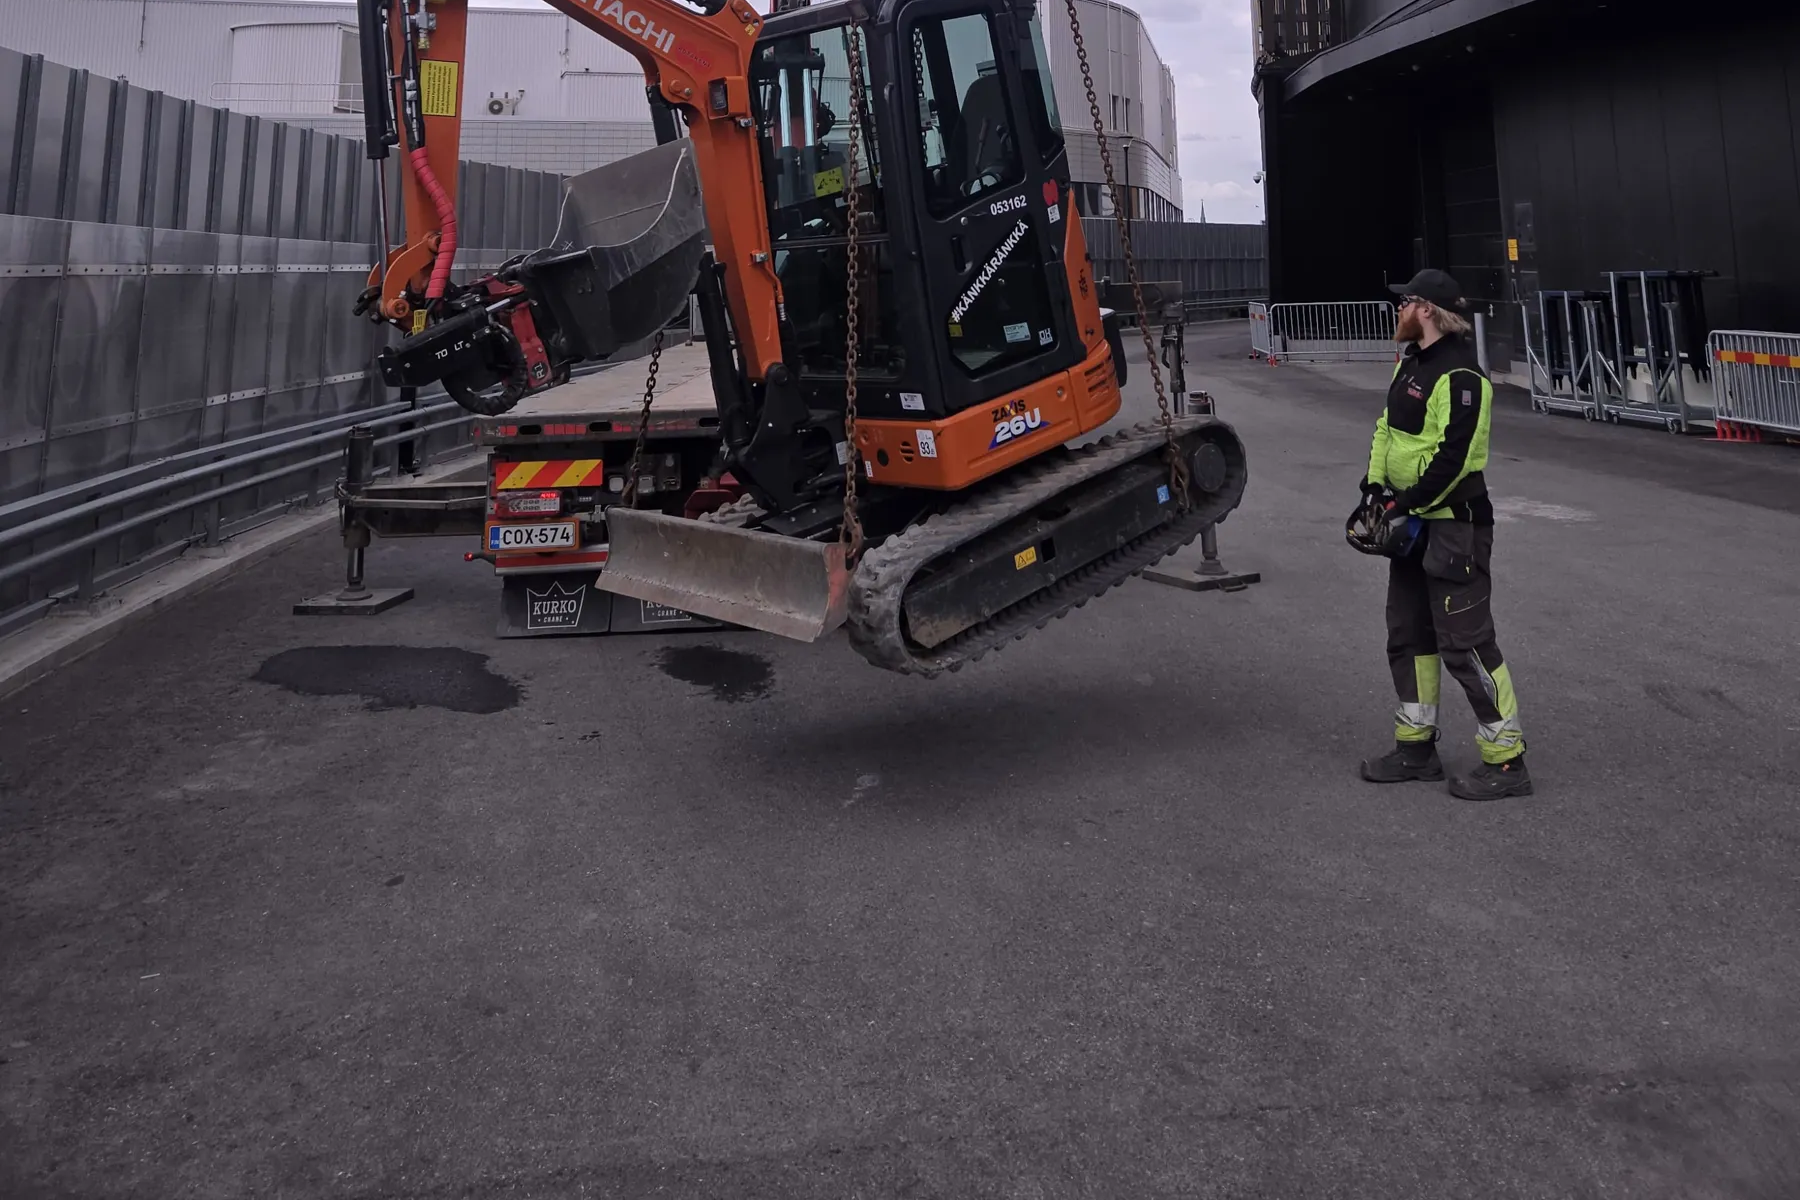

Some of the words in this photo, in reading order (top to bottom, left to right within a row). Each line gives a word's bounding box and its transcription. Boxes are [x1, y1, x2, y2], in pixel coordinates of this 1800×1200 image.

[990, 194, 1027, 215] 053162
[951, 219, 1029, 323] #KÄNKKÄRÄNKKÄ
[991, 399, 1026, 423] ZAXIS
[994, 407, 1041, 443] 26U
[920, 441, 931, 455] 93
[503, 527, 570, 545] COX-574
[533, 600, 577, 615] KURKO
